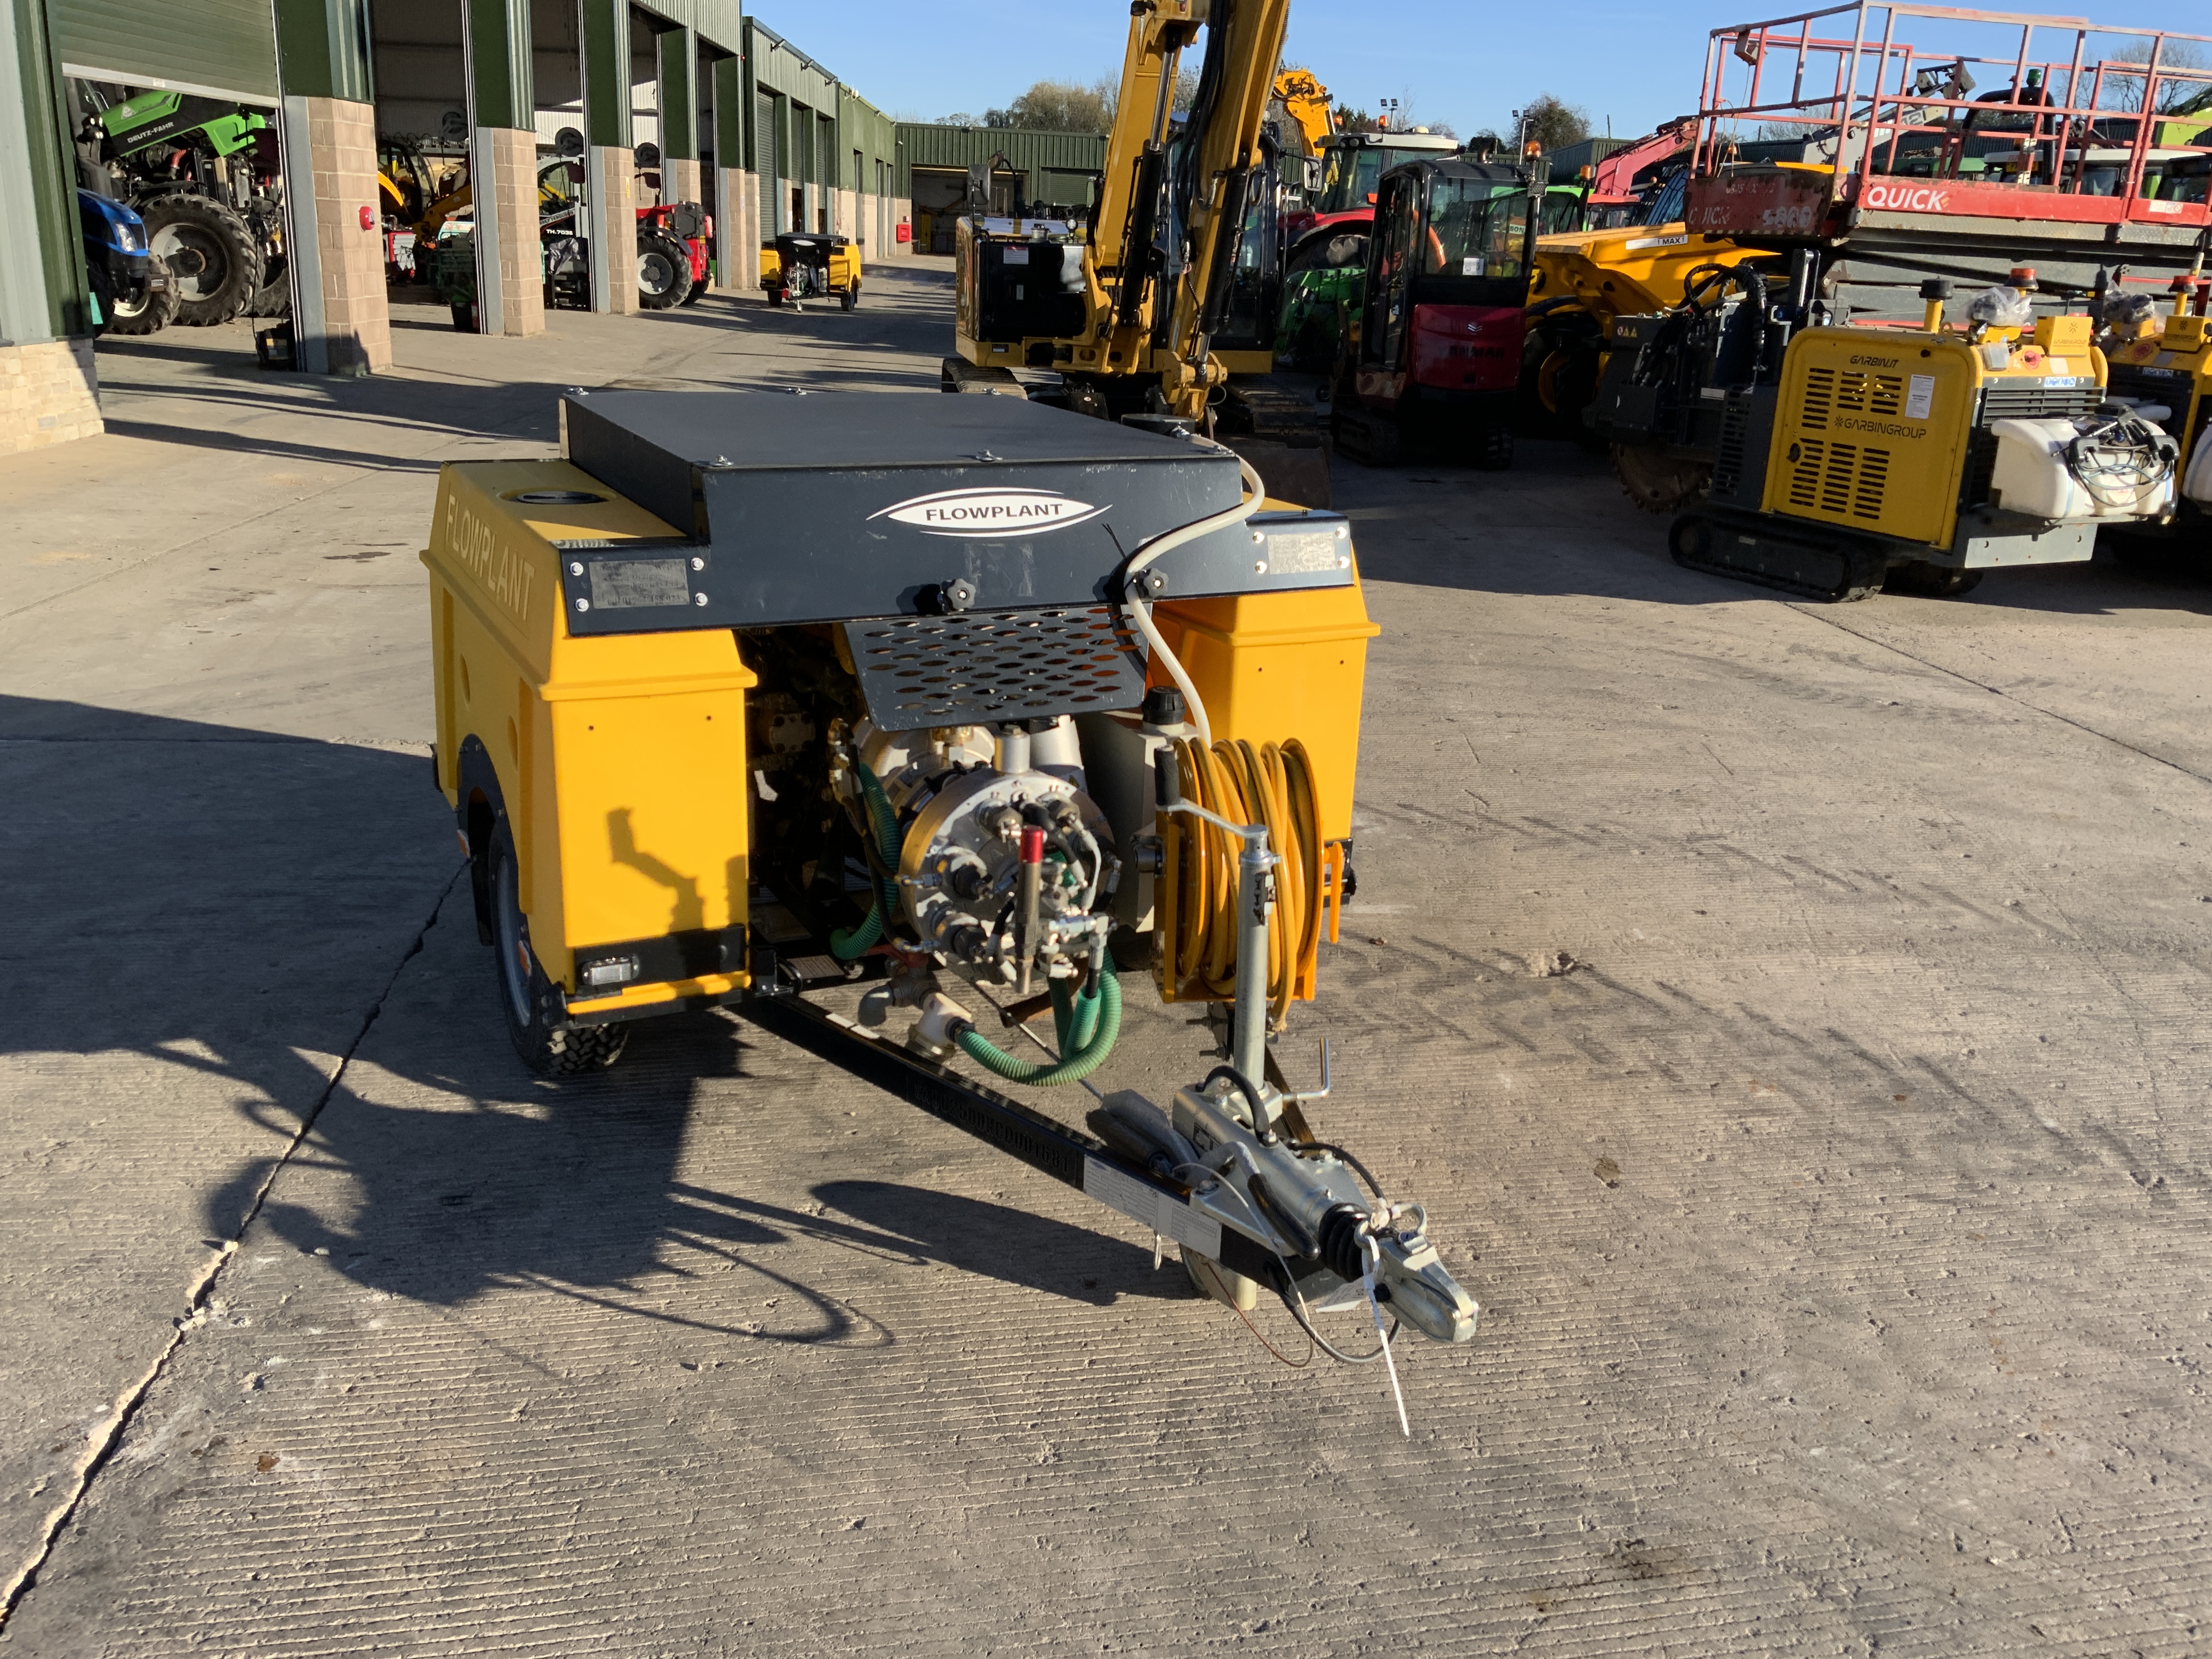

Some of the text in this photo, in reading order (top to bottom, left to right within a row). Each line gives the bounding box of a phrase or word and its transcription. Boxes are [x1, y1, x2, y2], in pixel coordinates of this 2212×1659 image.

[127, 121, 174, 143] DEUTZ-FAHR
[1867, 187, 1948, 210] QUICK
[1850, 356, 1899, 368] GARBIN.IT
[1844, 418, 1927, 439] GARBINGROUP
[926, 504, 1063, 521] FLOWPLANT
[445, 494, 535, 621] FLOWPLANT
